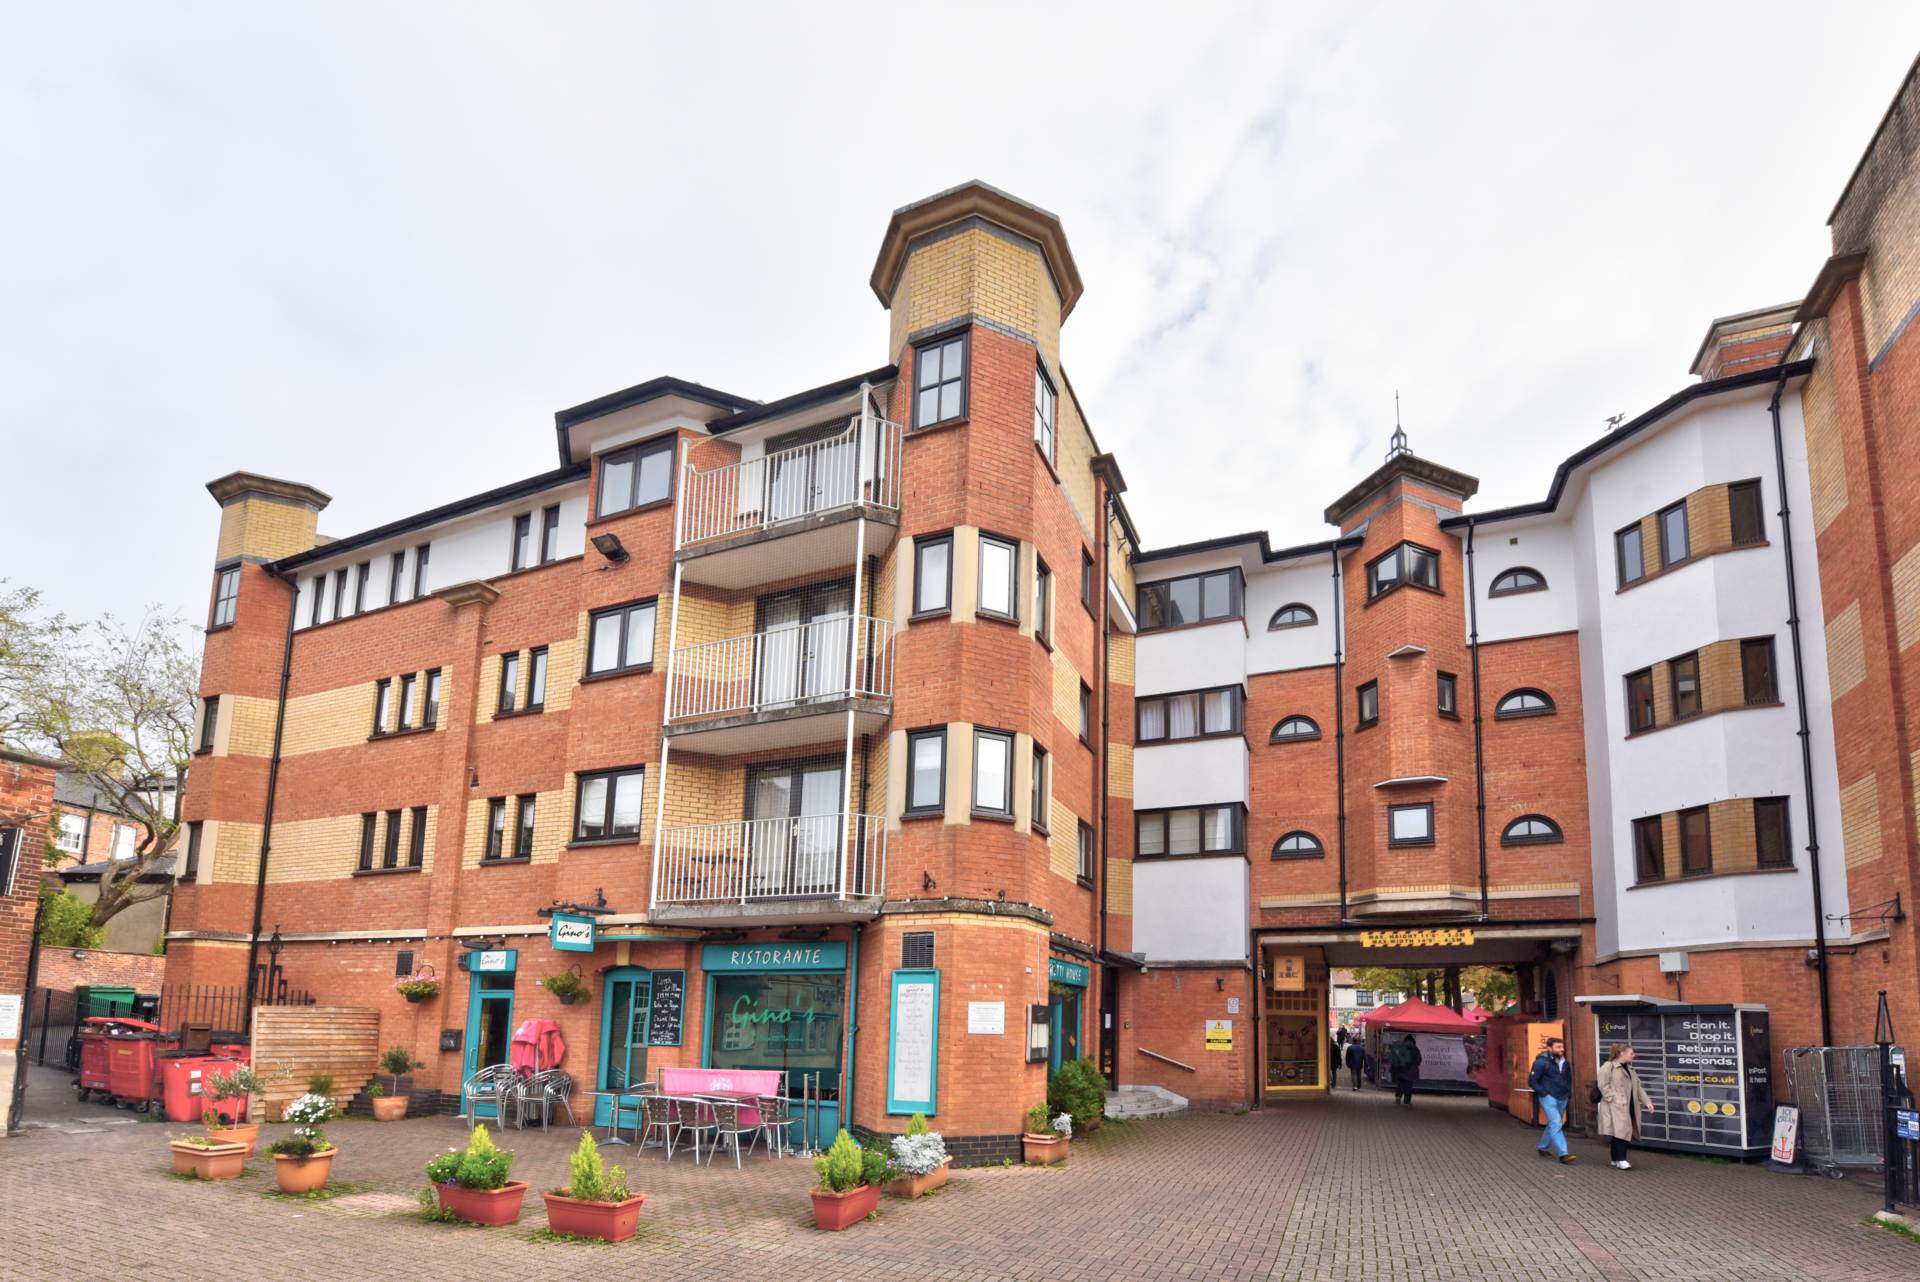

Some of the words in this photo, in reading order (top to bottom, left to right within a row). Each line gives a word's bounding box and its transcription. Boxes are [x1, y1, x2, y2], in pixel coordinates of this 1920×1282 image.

[558, 924, 591, 938] Gino's
[731, 949, 821, 965] RISTORANTE
[731, 991, 816, 1030] Gino's
[1682, 1022, 1715, 1030] Scan
[1718, 1022, 1731, 1030] it.
[1689, 1032, 1722, 1042] Drop
[1724, 1032, 1736, 1041] it.
[1677, 1045, 1722, 1053] Return
[1724, 1045, 1735, 1053] in
[1678, 1057, 1736, 1066] seconds.
[1668, 1073, 1735, 1084] inpost.co.uk
